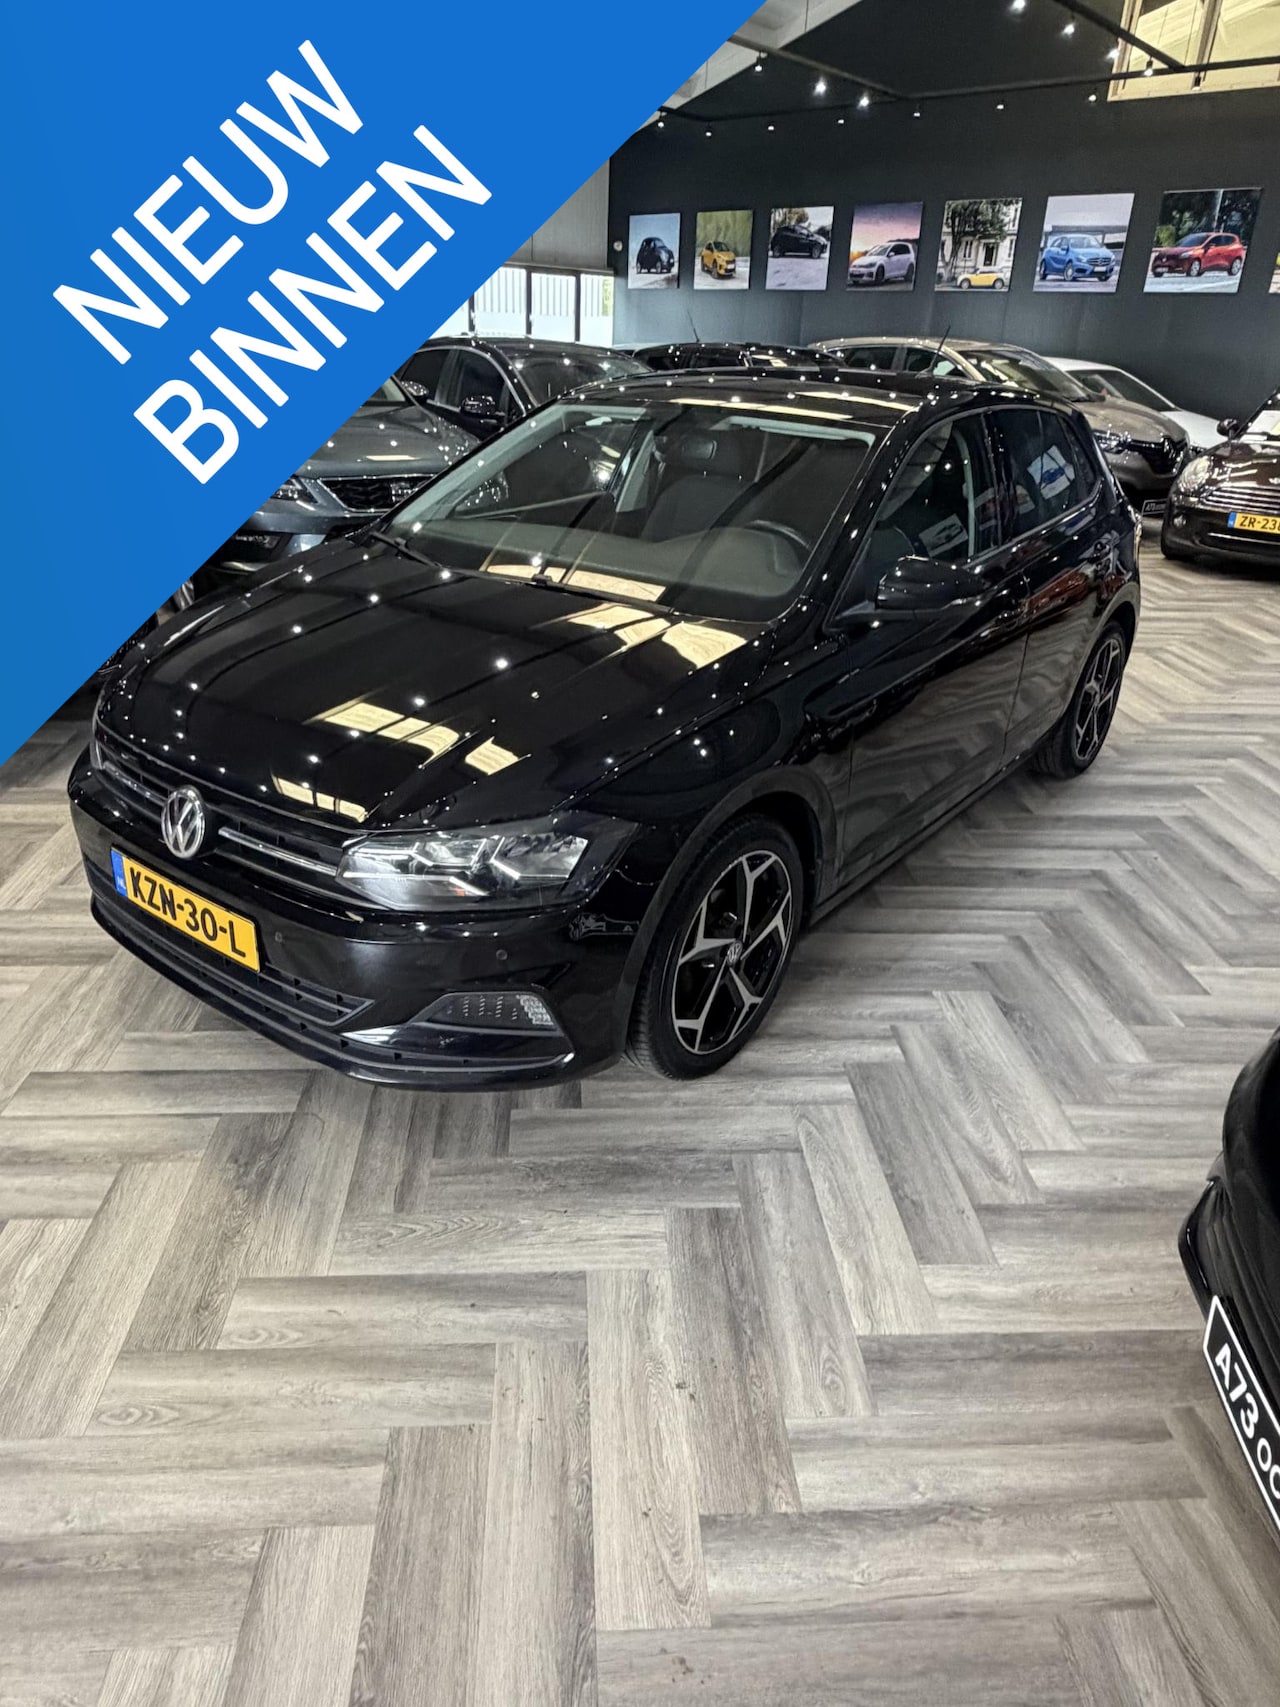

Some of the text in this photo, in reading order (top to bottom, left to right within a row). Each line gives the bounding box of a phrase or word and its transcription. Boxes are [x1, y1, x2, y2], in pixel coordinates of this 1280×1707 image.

[1239, 515, 1280, 532] ZR-23
[129, 866, 246, 958] KZN-30-L
[1214, 1342, 1259, 1440] A73
